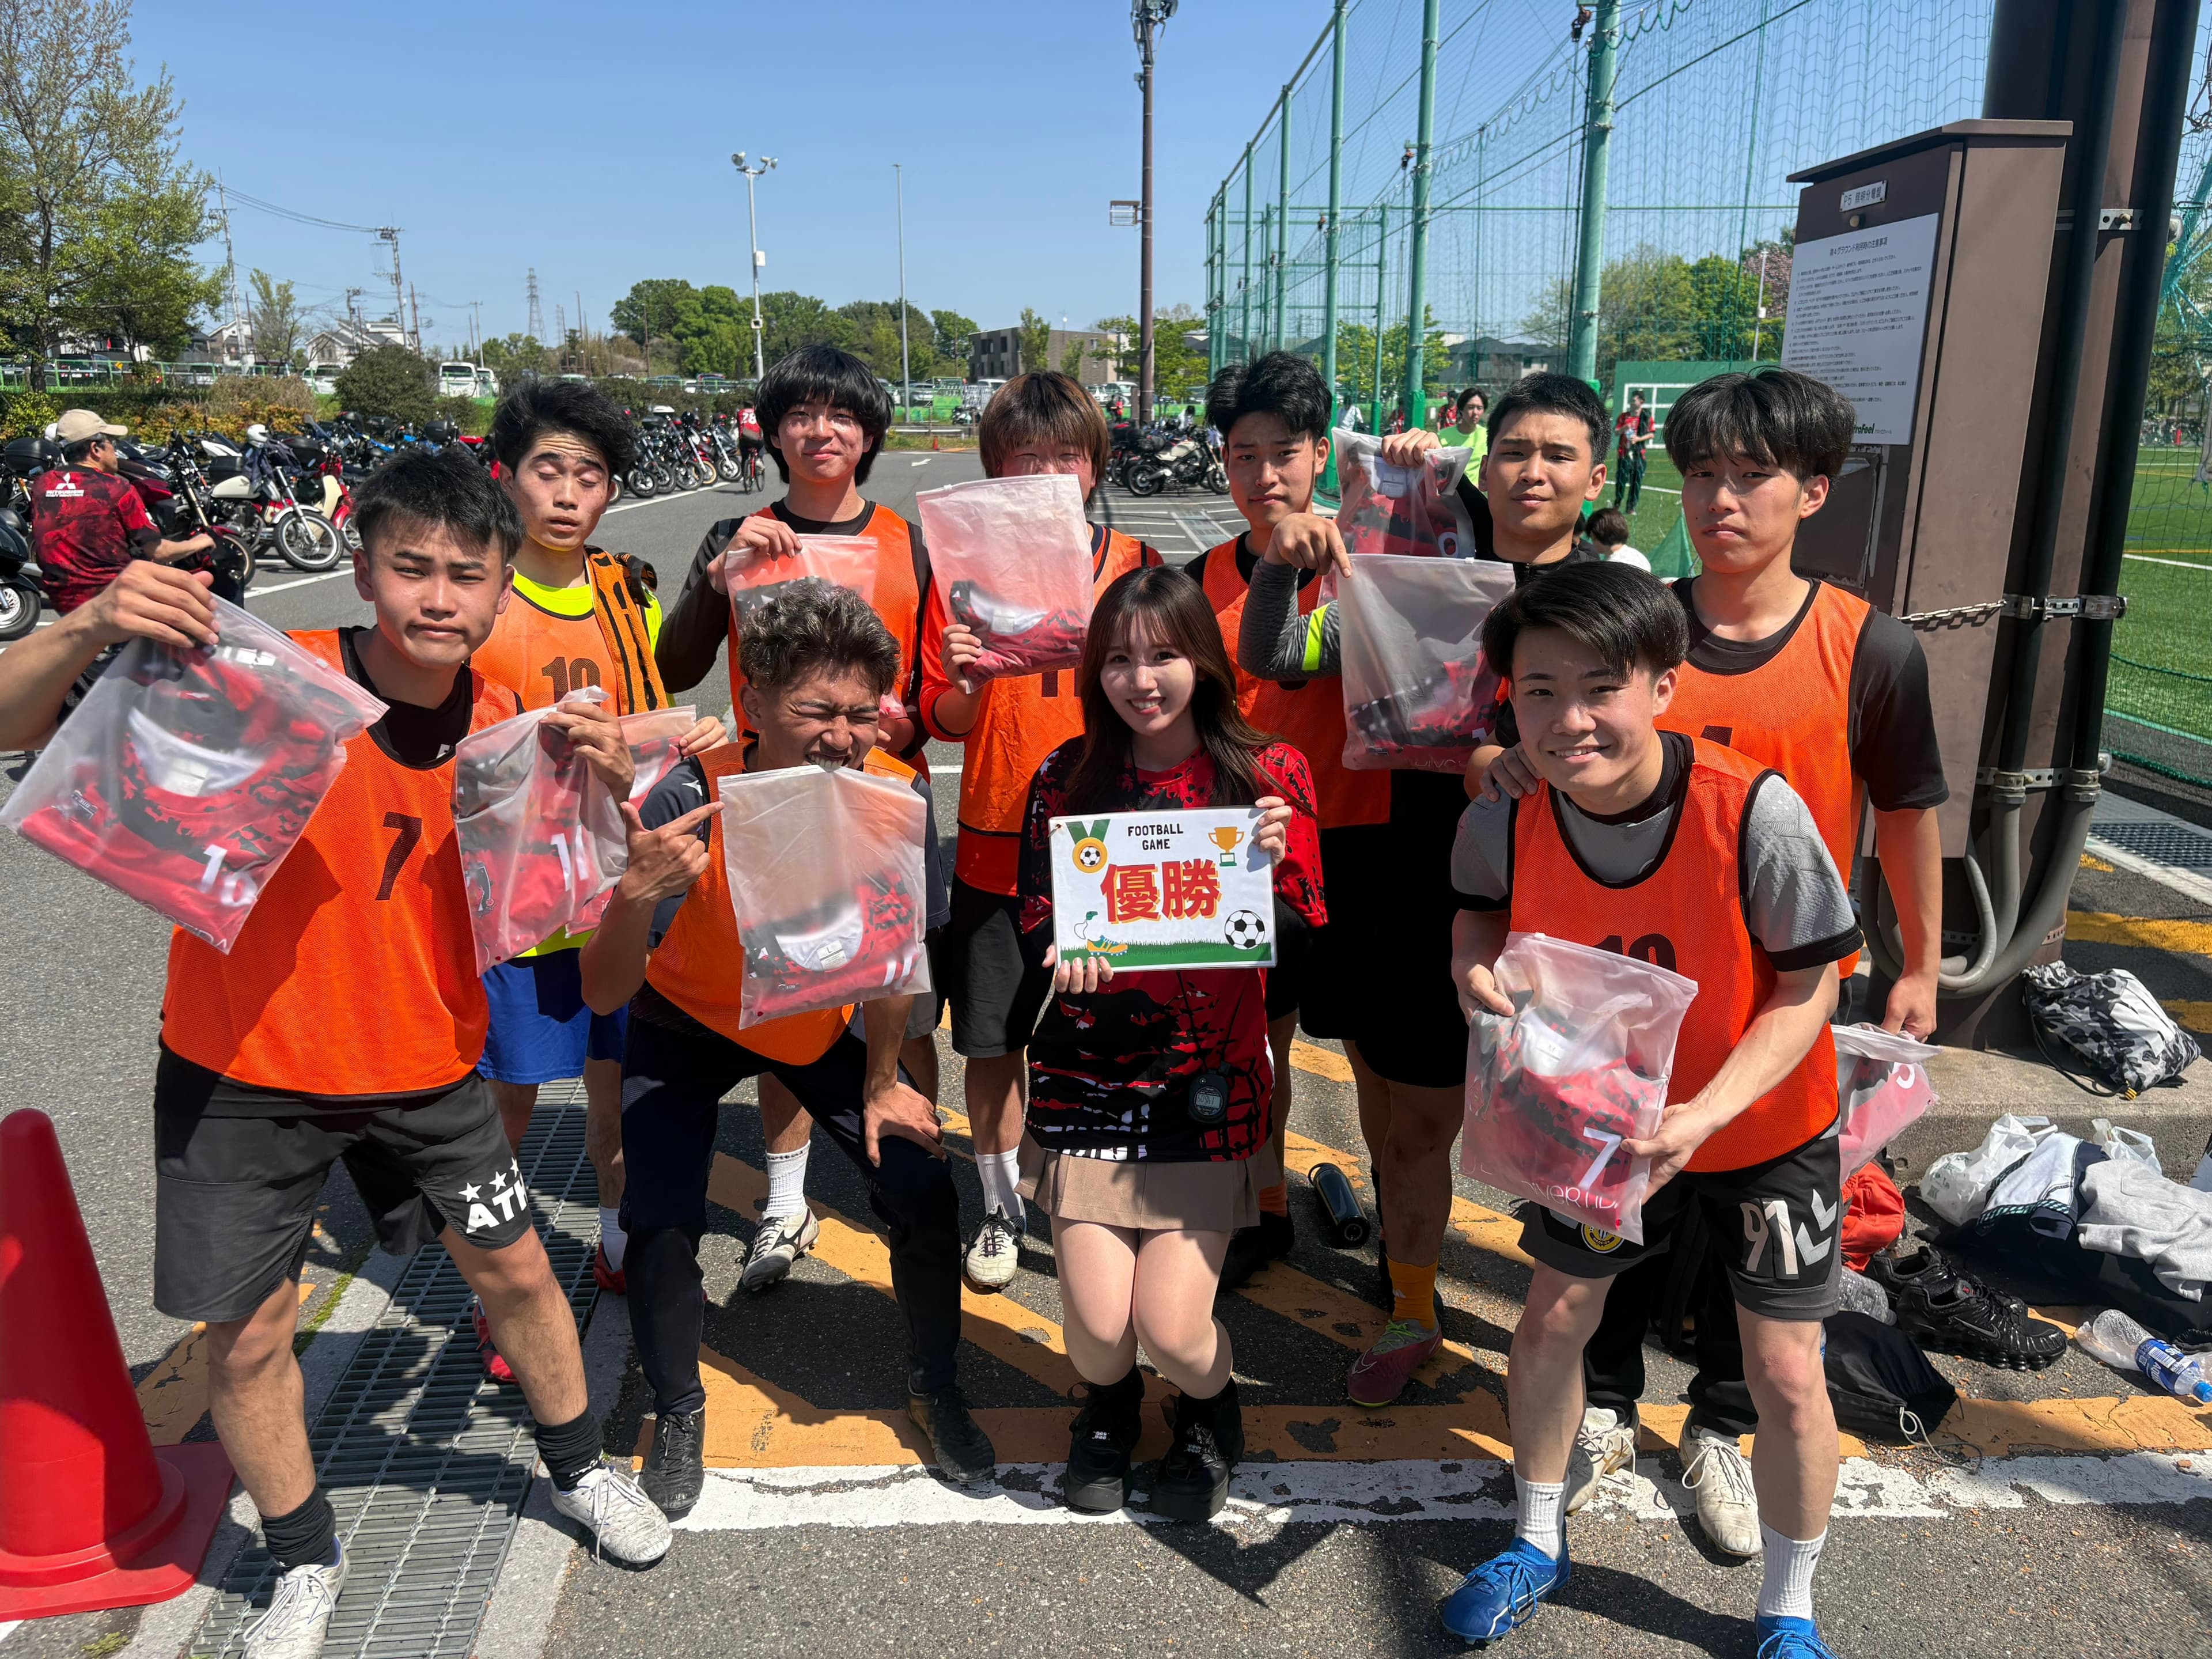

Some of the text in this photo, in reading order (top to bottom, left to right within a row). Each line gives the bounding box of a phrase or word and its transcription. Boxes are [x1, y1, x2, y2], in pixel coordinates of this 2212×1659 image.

[376, 812, 422, 901] 7
[1127, 823, 1184, 836] FOOTBALL
[1142, 838, 1171, 850] GAME
[1100, 858, 1222, 925] 優勝
[1582, 1126, 1622, 1190] 7
[1739, 1200, 1798, 1275] 91
